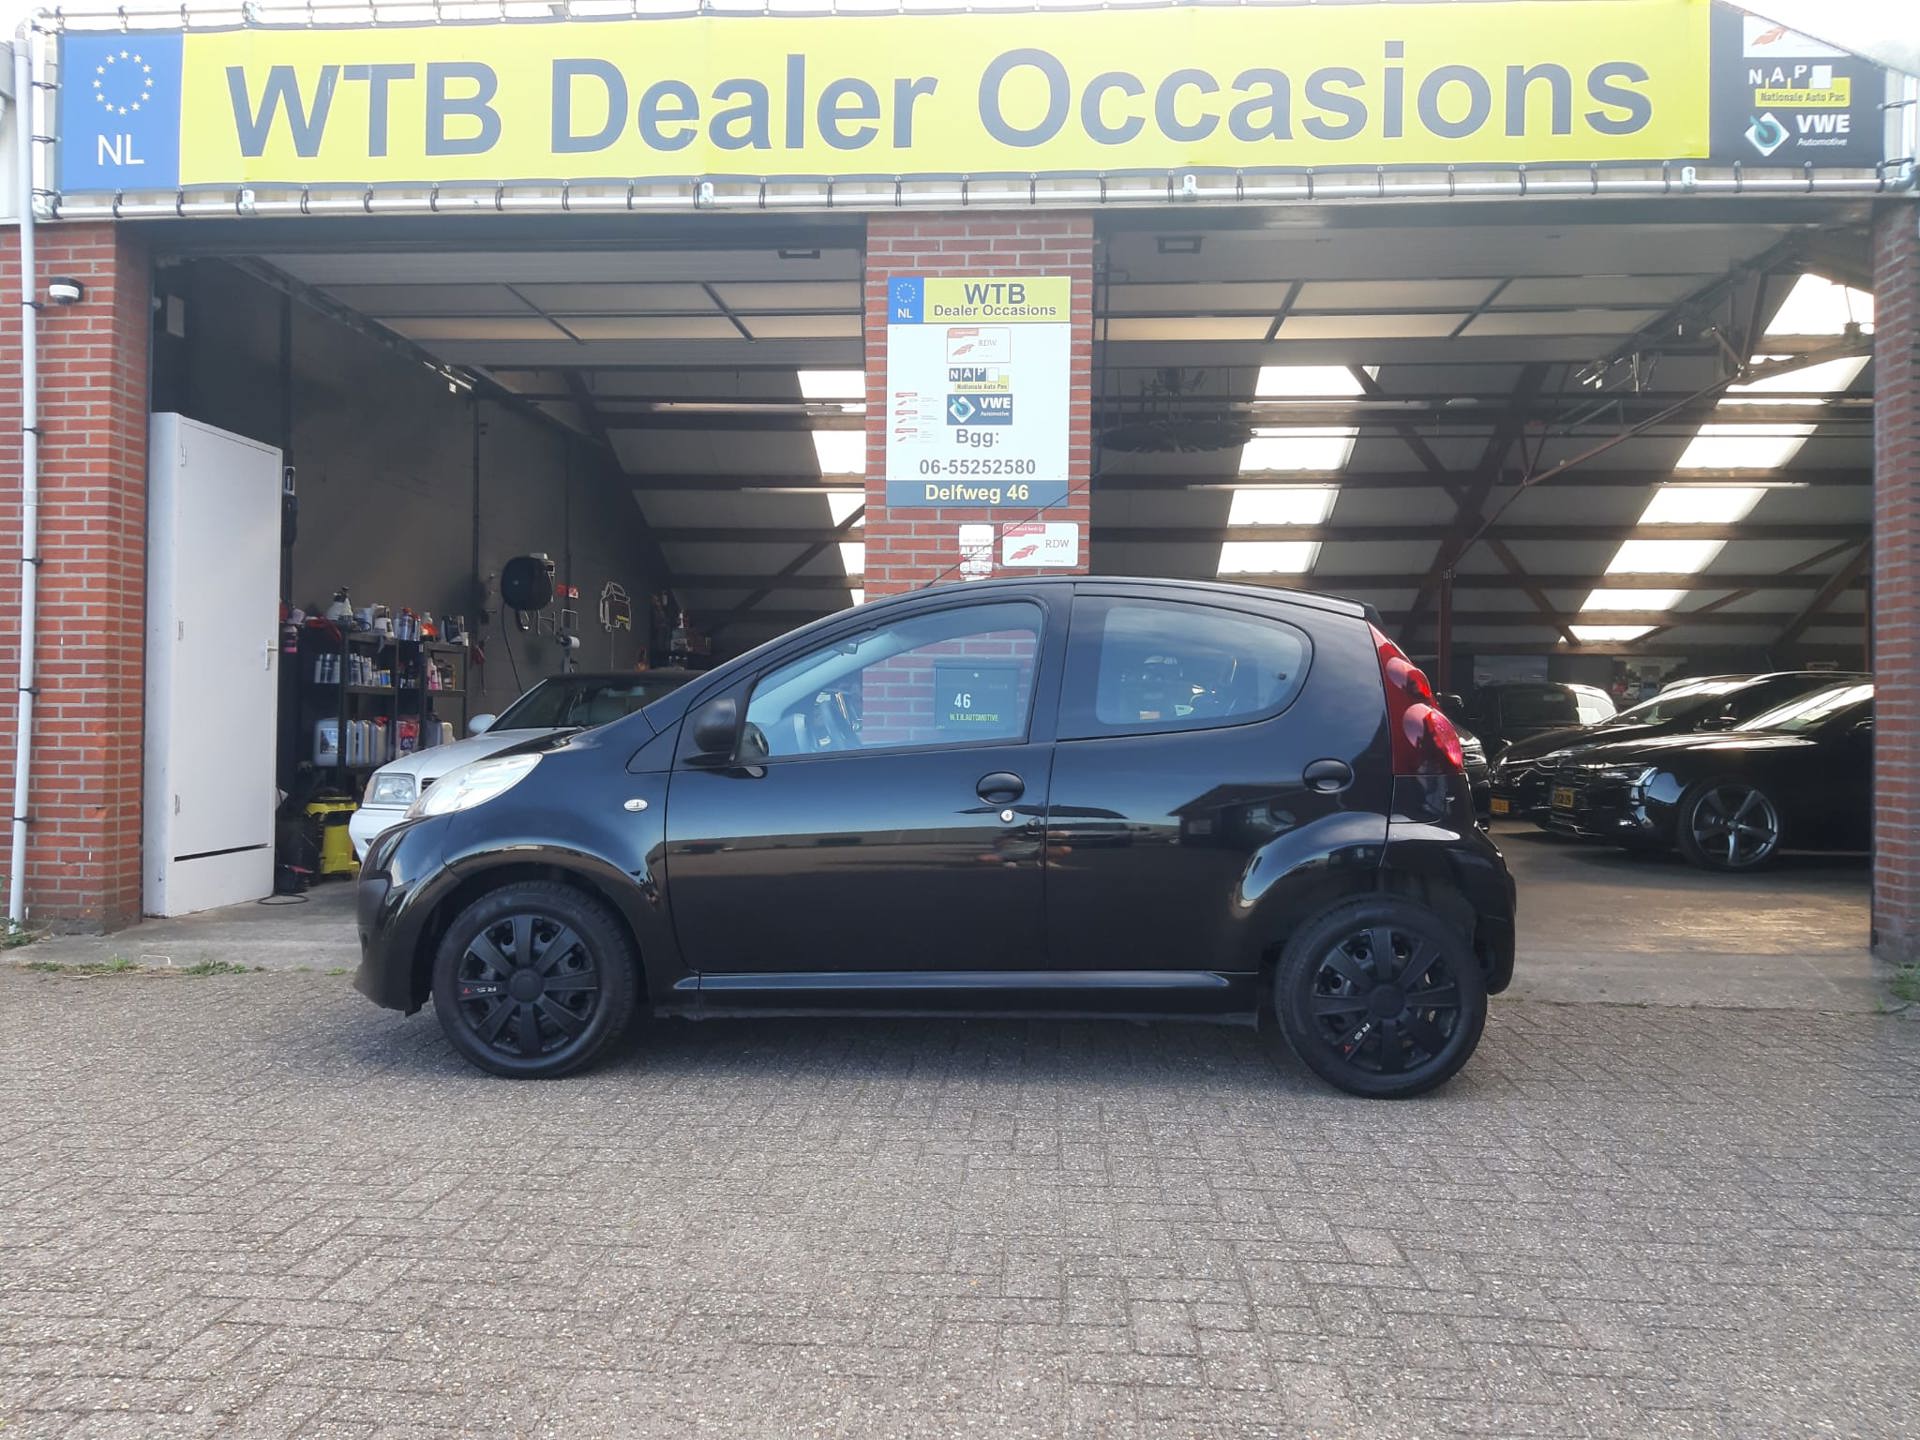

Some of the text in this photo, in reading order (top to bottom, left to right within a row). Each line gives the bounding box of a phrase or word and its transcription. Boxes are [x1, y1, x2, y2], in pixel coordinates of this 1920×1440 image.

[226, 40, 1653, 158] WTB Dealer Occasions
[1761, 92, 1803, 102] Nationale
[1805, 92, 1827, 102] Auto
[1796, 114, 1850, 133] VWE
[97, 135, 145, 165] NL
[1797, 138, 1848, 146] Automotive
[964, 283, 1026, 305] WTB
[897, 308, 913, 318] NL
[934, 304, 1057, 316] Dealer Occasions
[980, 397, 1011, 409] VWE
[956, 429, 1000, 447] Bgg:
[919, 459, 1036, 475] 06-55252580
[925, 484, 1029, 503] Delfweg 46
[1045, 539, 1070, 548] RDW
[954, 693, 972, 709] 46
